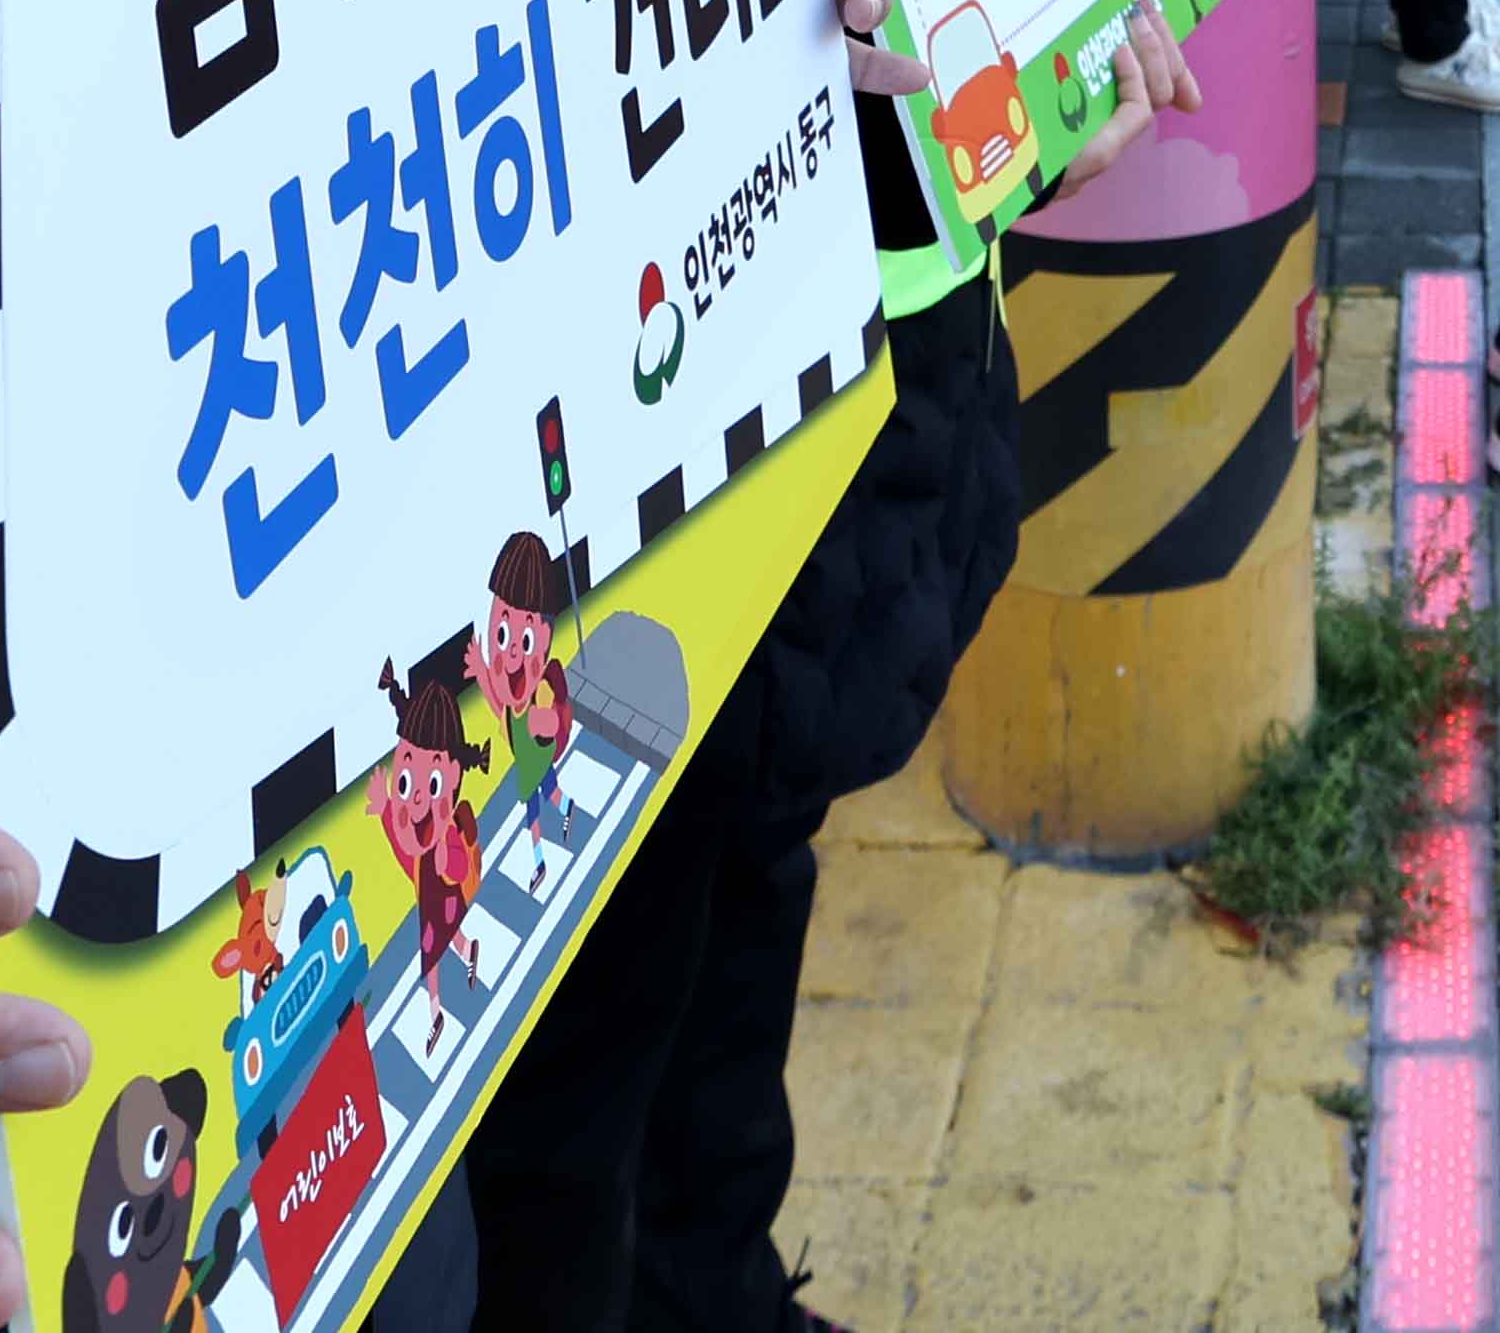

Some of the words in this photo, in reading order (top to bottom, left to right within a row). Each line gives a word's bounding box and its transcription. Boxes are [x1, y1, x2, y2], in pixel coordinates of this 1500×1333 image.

[684, 130, 797, 321] 인천광역시
[797, 84, 835, 179] 동구
[280, 1094, 364, 1222] 어린이보호
